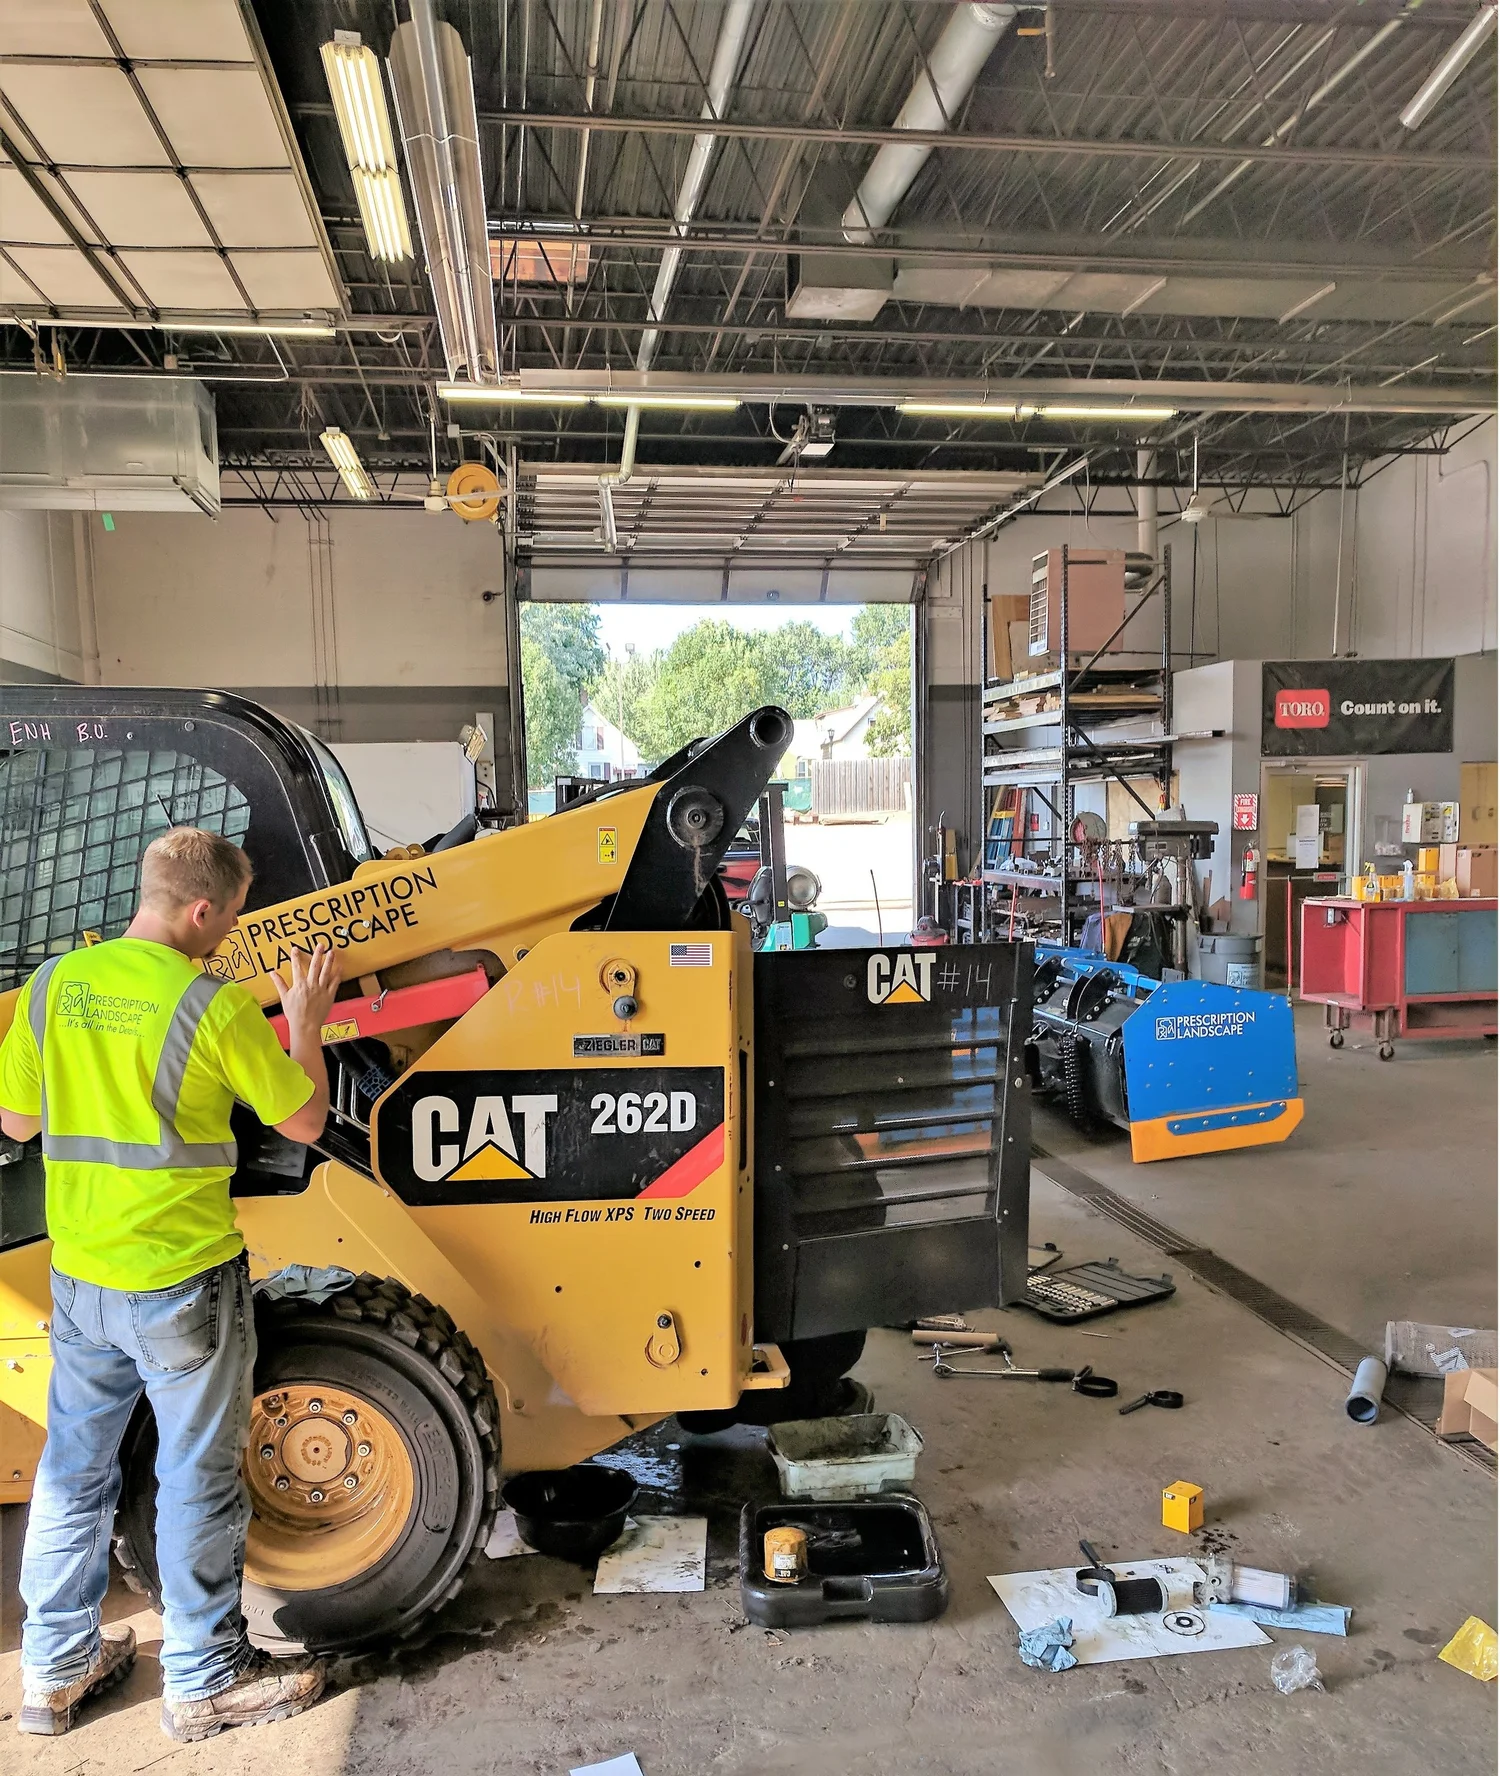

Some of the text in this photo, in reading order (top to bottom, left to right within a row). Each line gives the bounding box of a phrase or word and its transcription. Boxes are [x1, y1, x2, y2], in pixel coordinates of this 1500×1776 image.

[1280, 701, 1325, 717] TORO
[1340, 699, 1442, 716] Count on it.
[9, 721, 108, 746] ENH B.U.
[247, 866, 438, 948] PRESCRIPTION
[256, 902, 419, 974] LANDSCAPE
[867, 952, 937, 1005] CAT
[88, 993, 160, 1014] PRESCRIPTION
[85, 1007, 143, 1025] LANDSCAPE
[1176, 1011, 1256, 1028] PRESCRIPTION
[81, 1019, 94, 1029] all
[95, 1021, 105, 1031] in
[106, 1023, 117, 1033] the
[1176, 1023, 1243, 1039] LANDSCAPE
[584, 1038, 662, 1052] ZIEGLER CAT
[590, 1091, 697, 1134] 262D
[411, 1094, 558, 1182] CAT
[530, 1206, 716, 1224] HIGH FLOW XPS TWO SPEED
